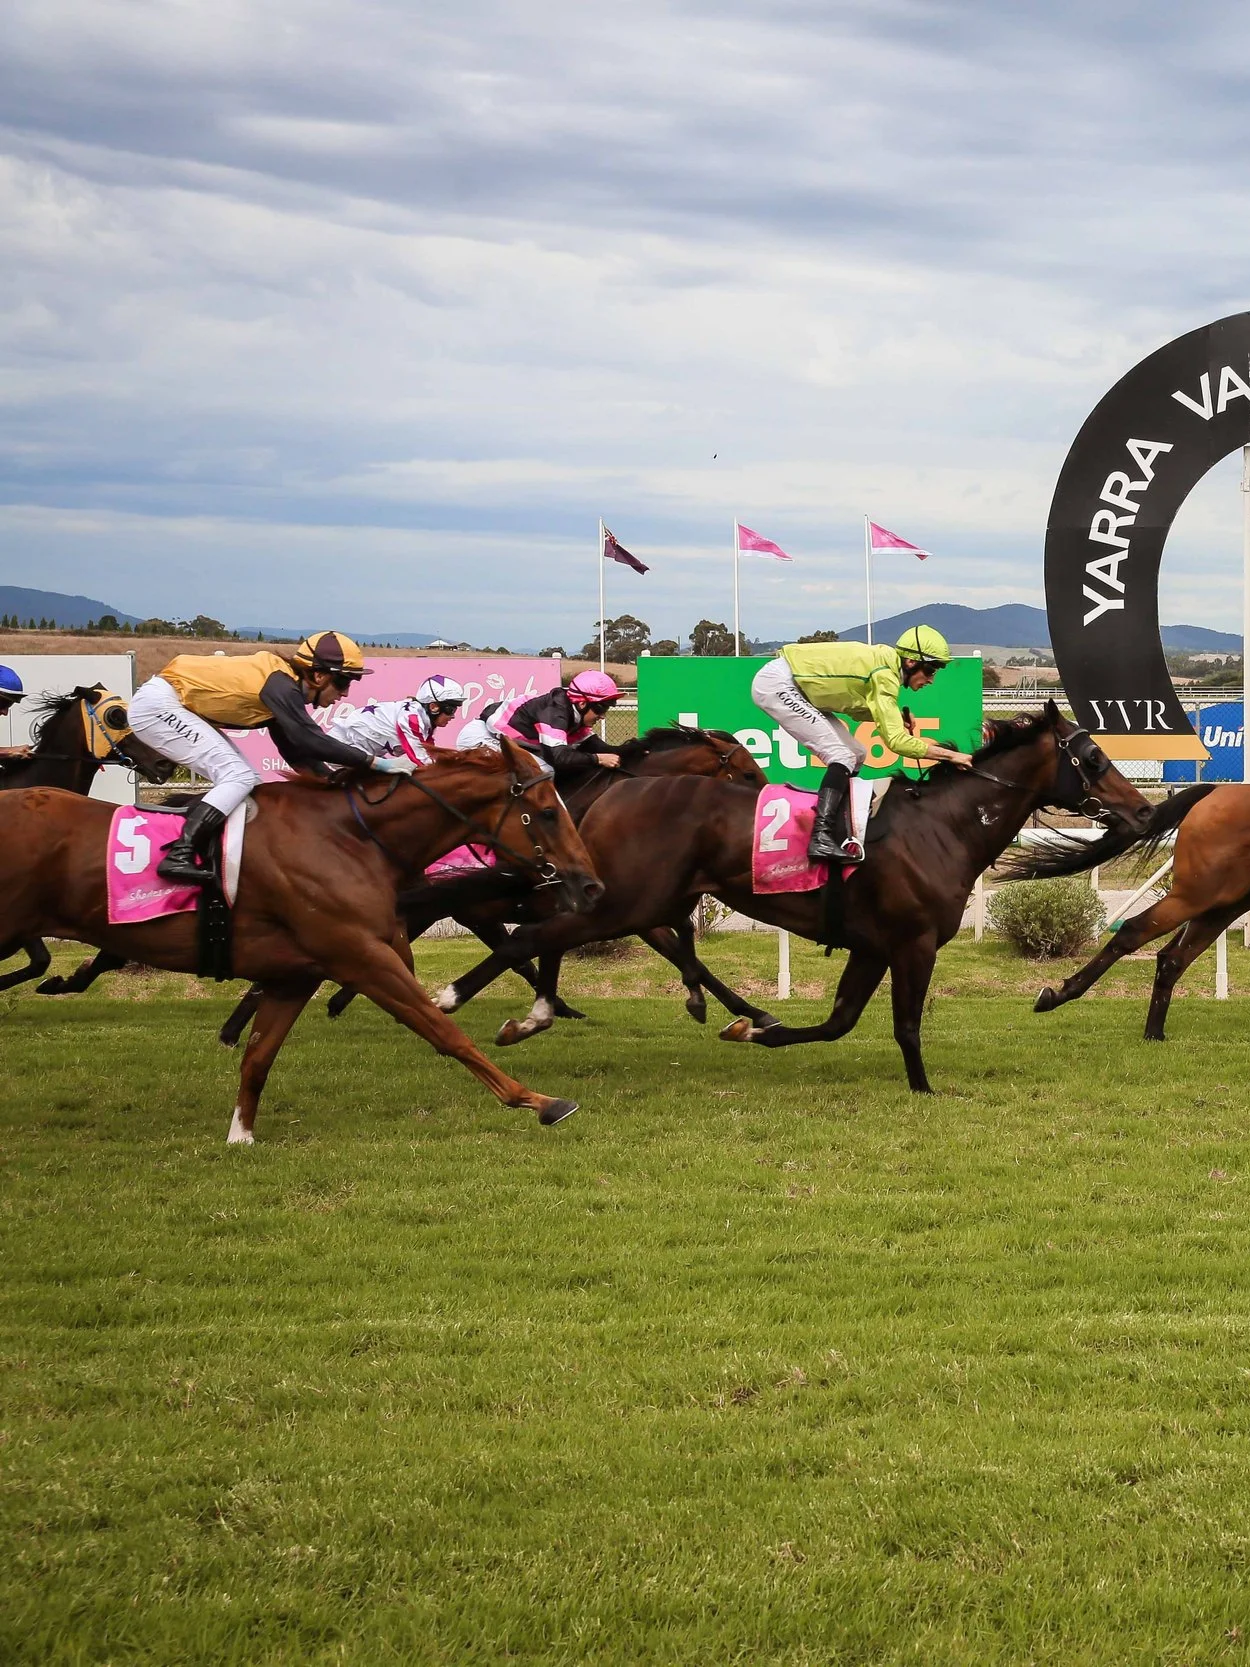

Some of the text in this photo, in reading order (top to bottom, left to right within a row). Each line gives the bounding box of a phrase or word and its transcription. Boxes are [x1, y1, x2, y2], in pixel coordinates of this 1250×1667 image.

[1082, 438, 1174, 627] YARRA
[1088, 700, 1174, 731] YVR
[1203, 726, 1244, 748] Uni
[262, 758, 291, 771] SHA
[114, 815, 151, 875] 5
[759, 798, 791, 853] 2
